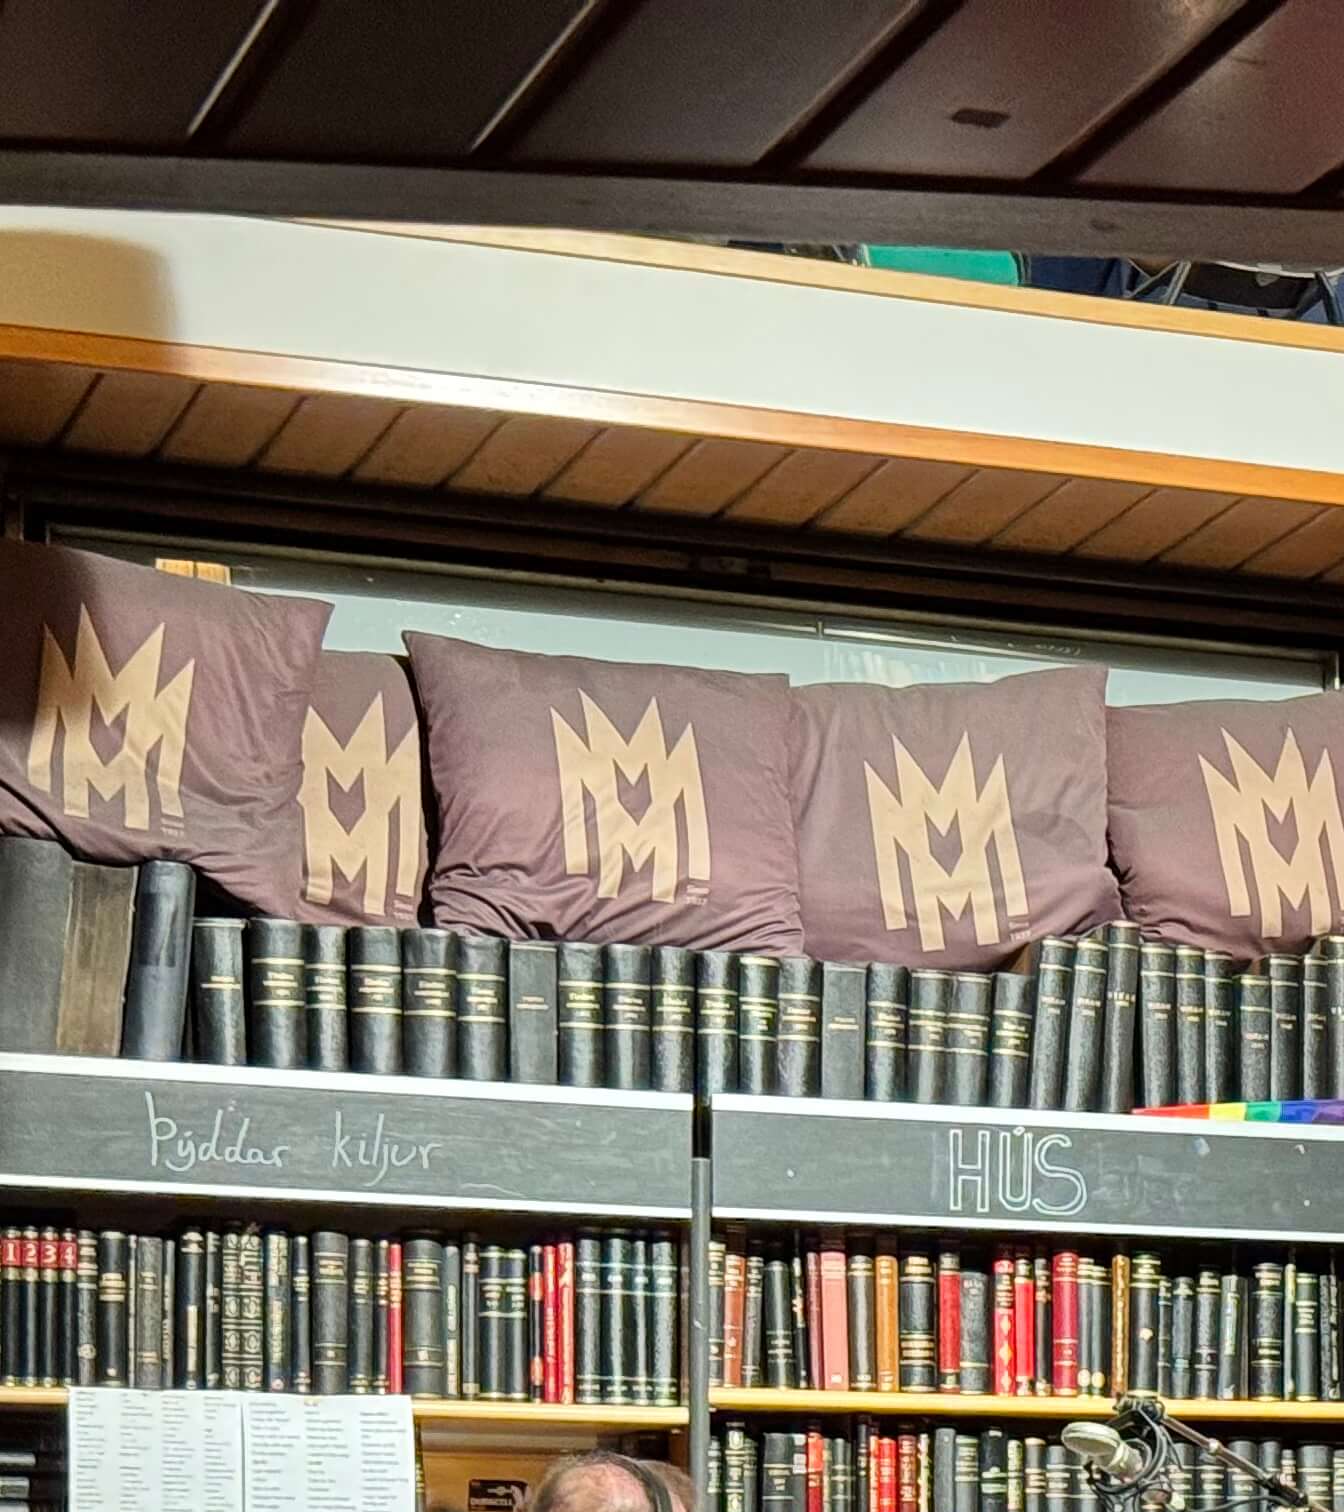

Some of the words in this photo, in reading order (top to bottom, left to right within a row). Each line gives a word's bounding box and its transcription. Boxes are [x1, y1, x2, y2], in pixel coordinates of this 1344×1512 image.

[332, 1110, 442, 1187] kiljur
[948, 1126, 1088, 1217] HÚS
[7, 1243, 17, 1263] 1
[25, 1243, 37, 1263] 2
[43, 1244, 57, 1264] 3
[63, 1245, 74, 1266] 4
